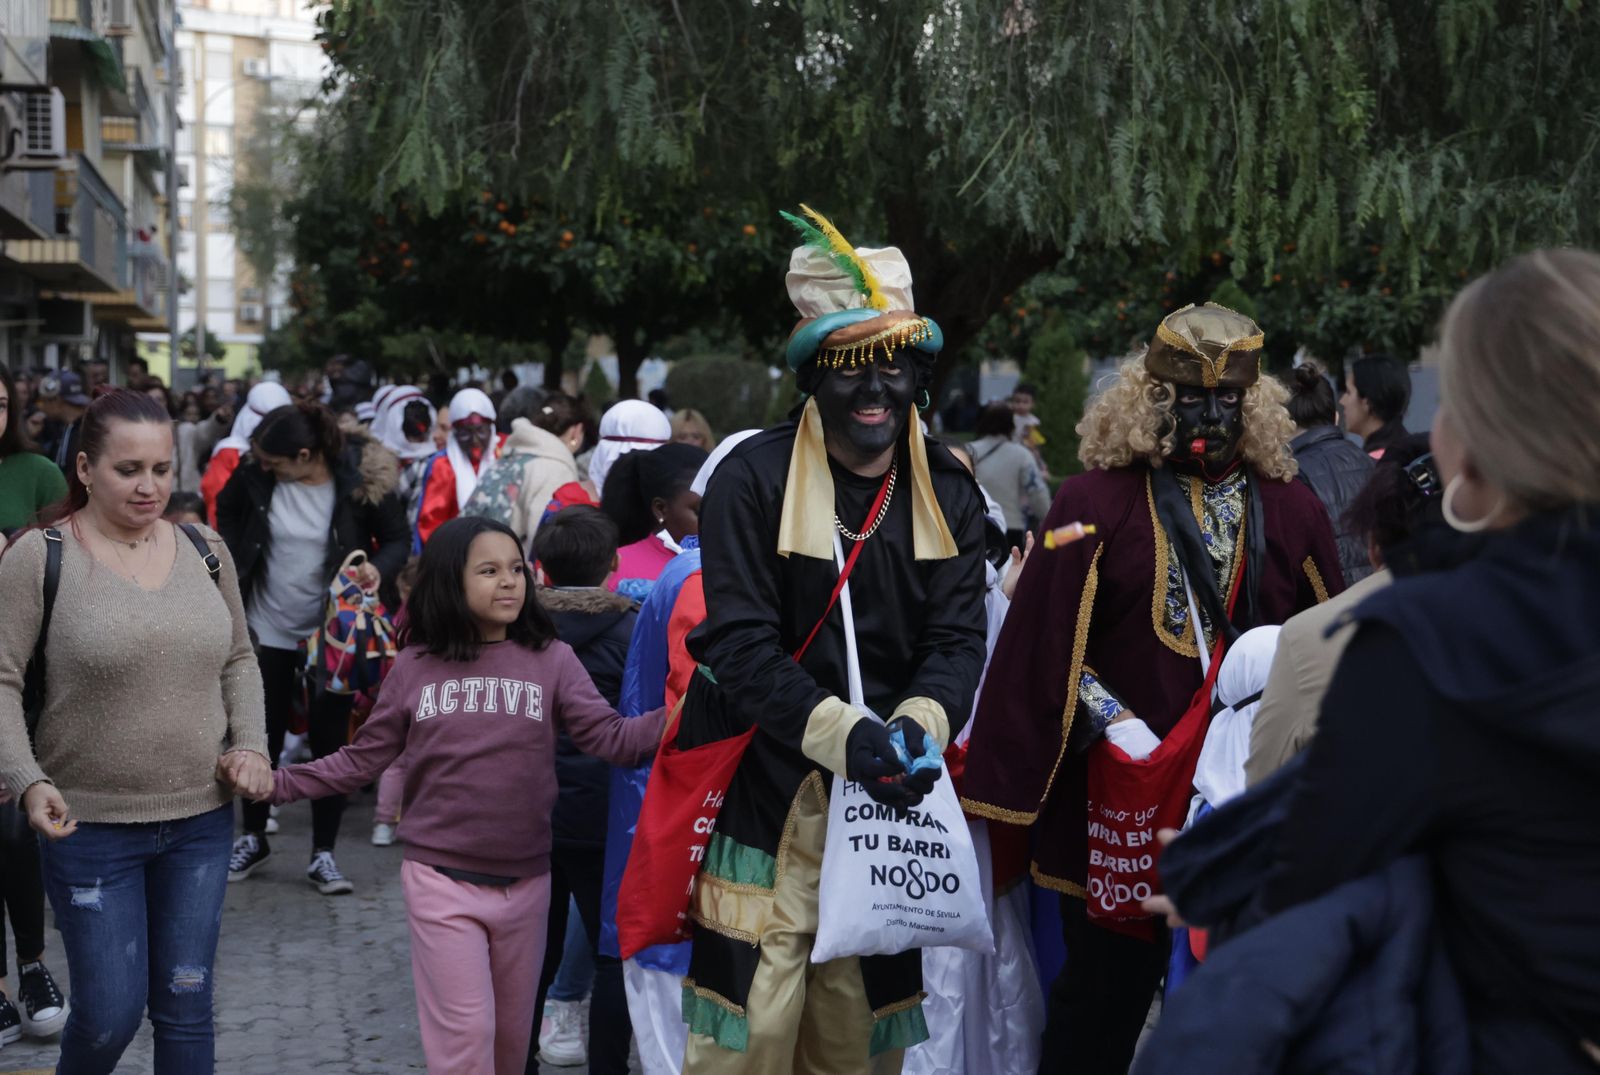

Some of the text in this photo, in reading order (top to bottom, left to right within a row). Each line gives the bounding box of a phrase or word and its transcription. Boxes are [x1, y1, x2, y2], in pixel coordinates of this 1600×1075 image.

[416, 677, 543, 722] ACTIVE
[1135, 804, 1159, 827] yo
[849, 834, 952, 859] TU BARRI
[1126, 827, 1153, 847] EN
[925, 909, 935, 917] DE
[909, 922, 945, 933] Macarena
